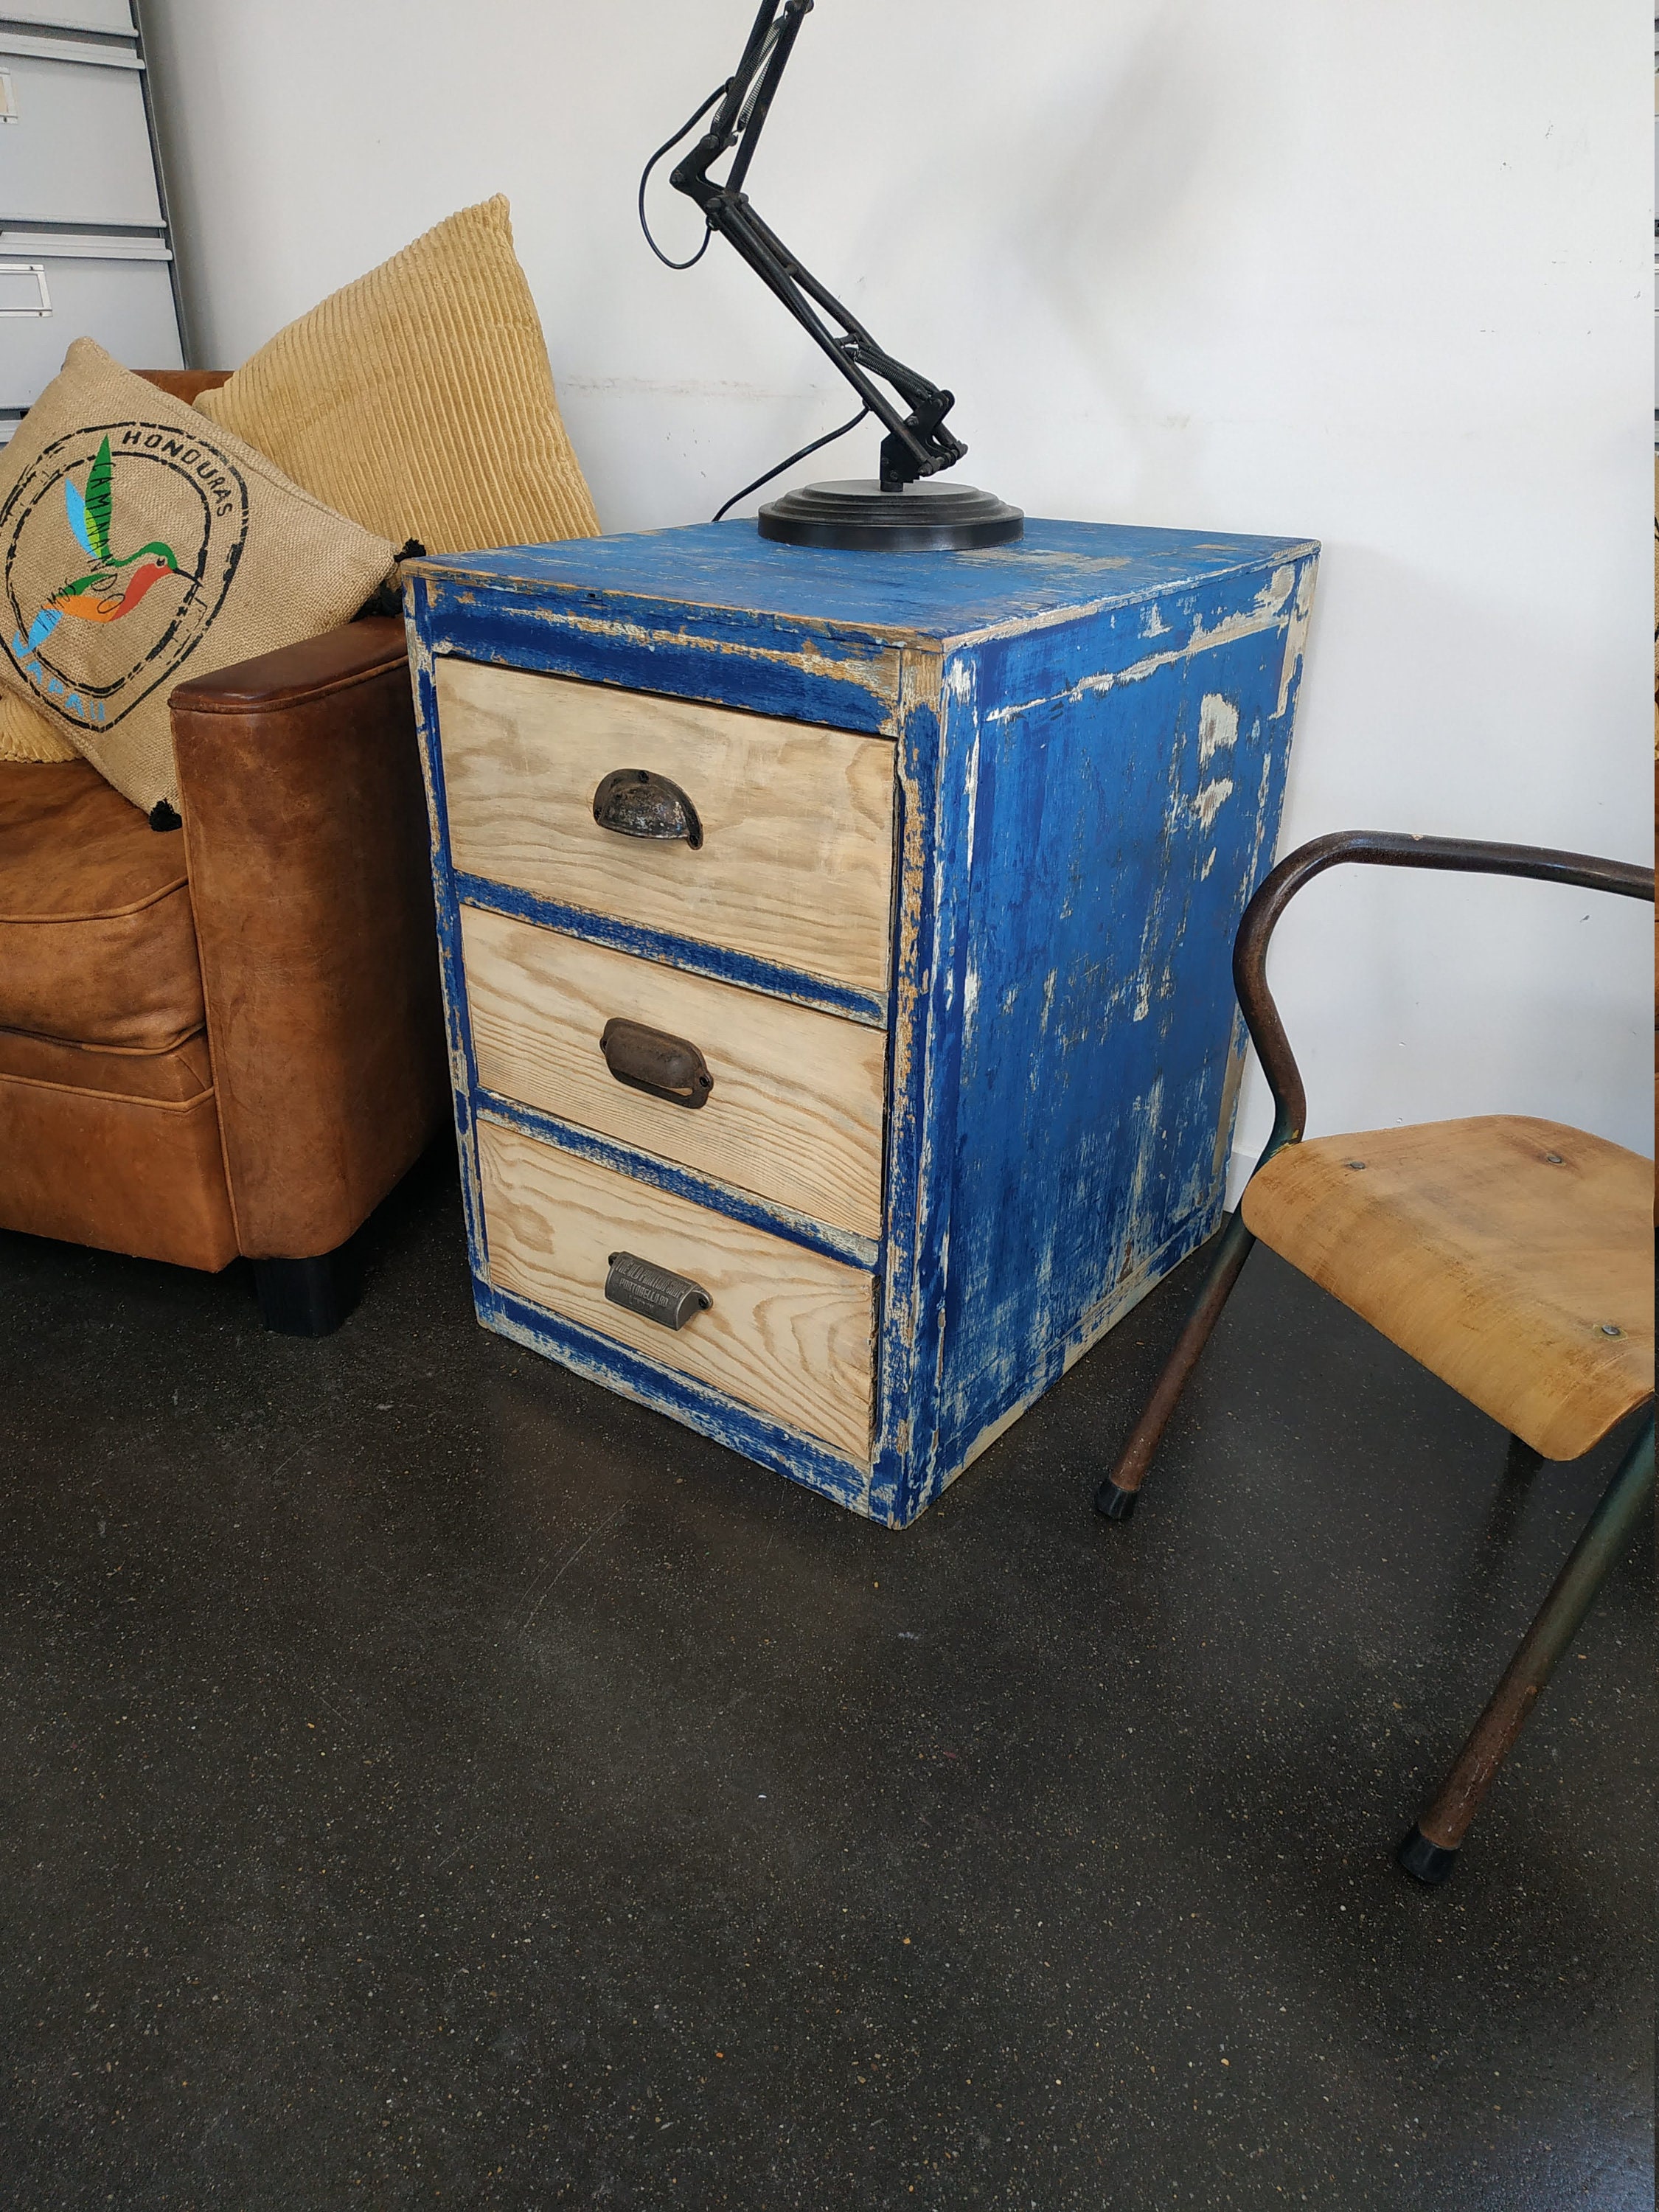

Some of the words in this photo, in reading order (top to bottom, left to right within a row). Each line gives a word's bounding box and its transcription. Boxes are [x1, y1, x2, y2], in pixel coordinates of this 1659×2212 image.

[122, 430, 233, 517] HONDURAS
[85, 462, 125, 614] CAMINANDO
[627, 1262, 644, 1279] OLD
